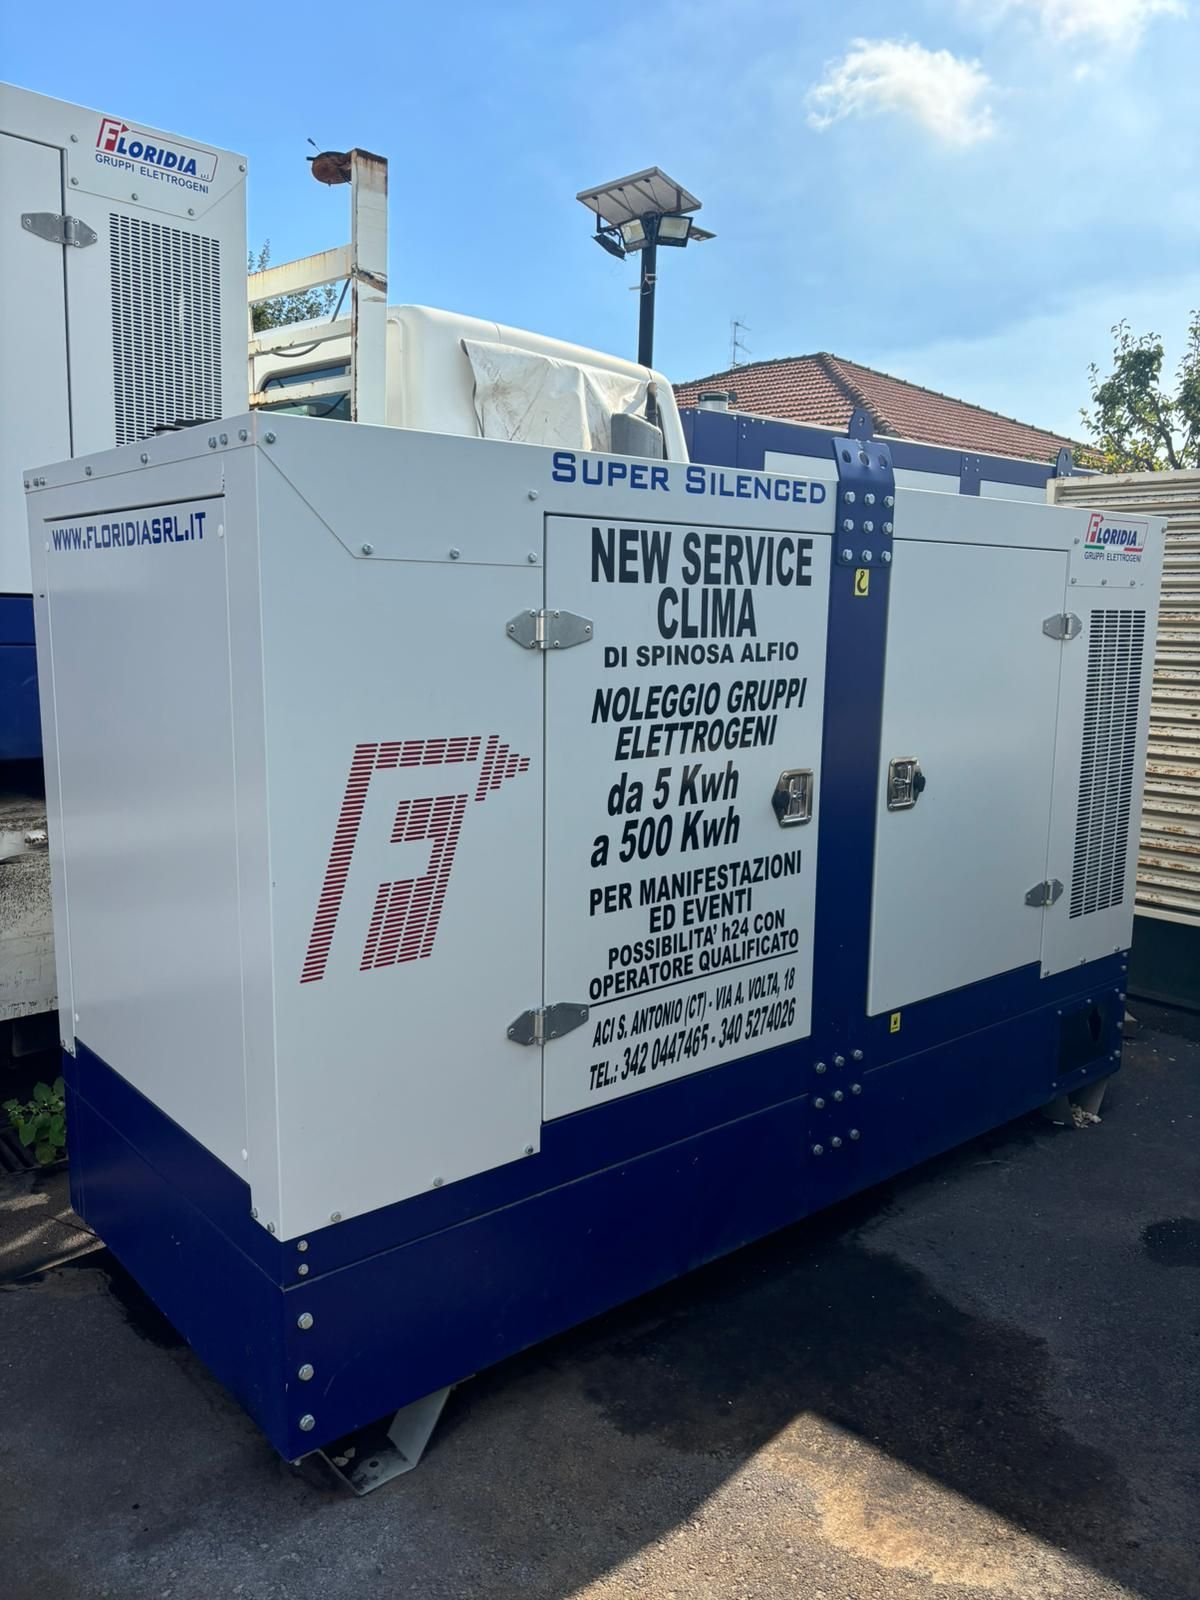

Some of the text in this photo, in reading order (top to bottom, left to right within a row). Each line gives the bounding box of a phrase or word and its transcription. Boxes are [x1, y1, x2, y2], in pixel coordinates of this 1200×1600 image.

[95, 154, 209, 194] GRUPPI ELETTROGENI
[96, 118, 197, 176] FLORIDIA
[552, 451, 826, 505] SUPER SILENCED
[52, 512, 206, 551] WWW.FLORIDIASRL.IT
[1086, 513, 1138, 546] FLORIDIA
[591, 527, 814, 587] NEW SERVICE
[1084, 551, 1141, 563] GRUPPI ELETTROGENI
[657, 587, 757, 639] CLIMA
[604, 641, 799, 668] DI SPINOSA ALFIO
[591, 678, 807, 724] NOLEGGIO GRUPPI
[614, 714, 778, 761] ELETTROGENI
[608, 760, 739, 816] da 5 Kwh
[590, 805, 740, 868] a 500 Kwh
[589, 850, 802, 916] PER MANIFESTAZIONI
[650, 887, 752, 933] ED EVENTI
[589, 928, 799, 1000] OPERATORE QUALIFICATO
[608, 908, 785, 970] POSSIBILITA' h24 CON
[592, 1017, 615, 1048] ACI
[617, 1015, 628, 1040] S.
[631, 998, 682, 1035] ANTONIO
[684, 991, 707, 1027] (CT)
[716, 986, 732, 1011] VIA
[734, 984, 745, 1005] A.
[748, 972, 780, 1000] VOLTA,
[784, 967, 795, 990] 18
[589, 1060, 618, 1090] TEL.:
[621, 1043, 648, 1080] 342
[651, 1023, 710, 1068] 0447465
[719, 1014, 743, 1048] 340
[745, 998, 797, 1040] 5274026
